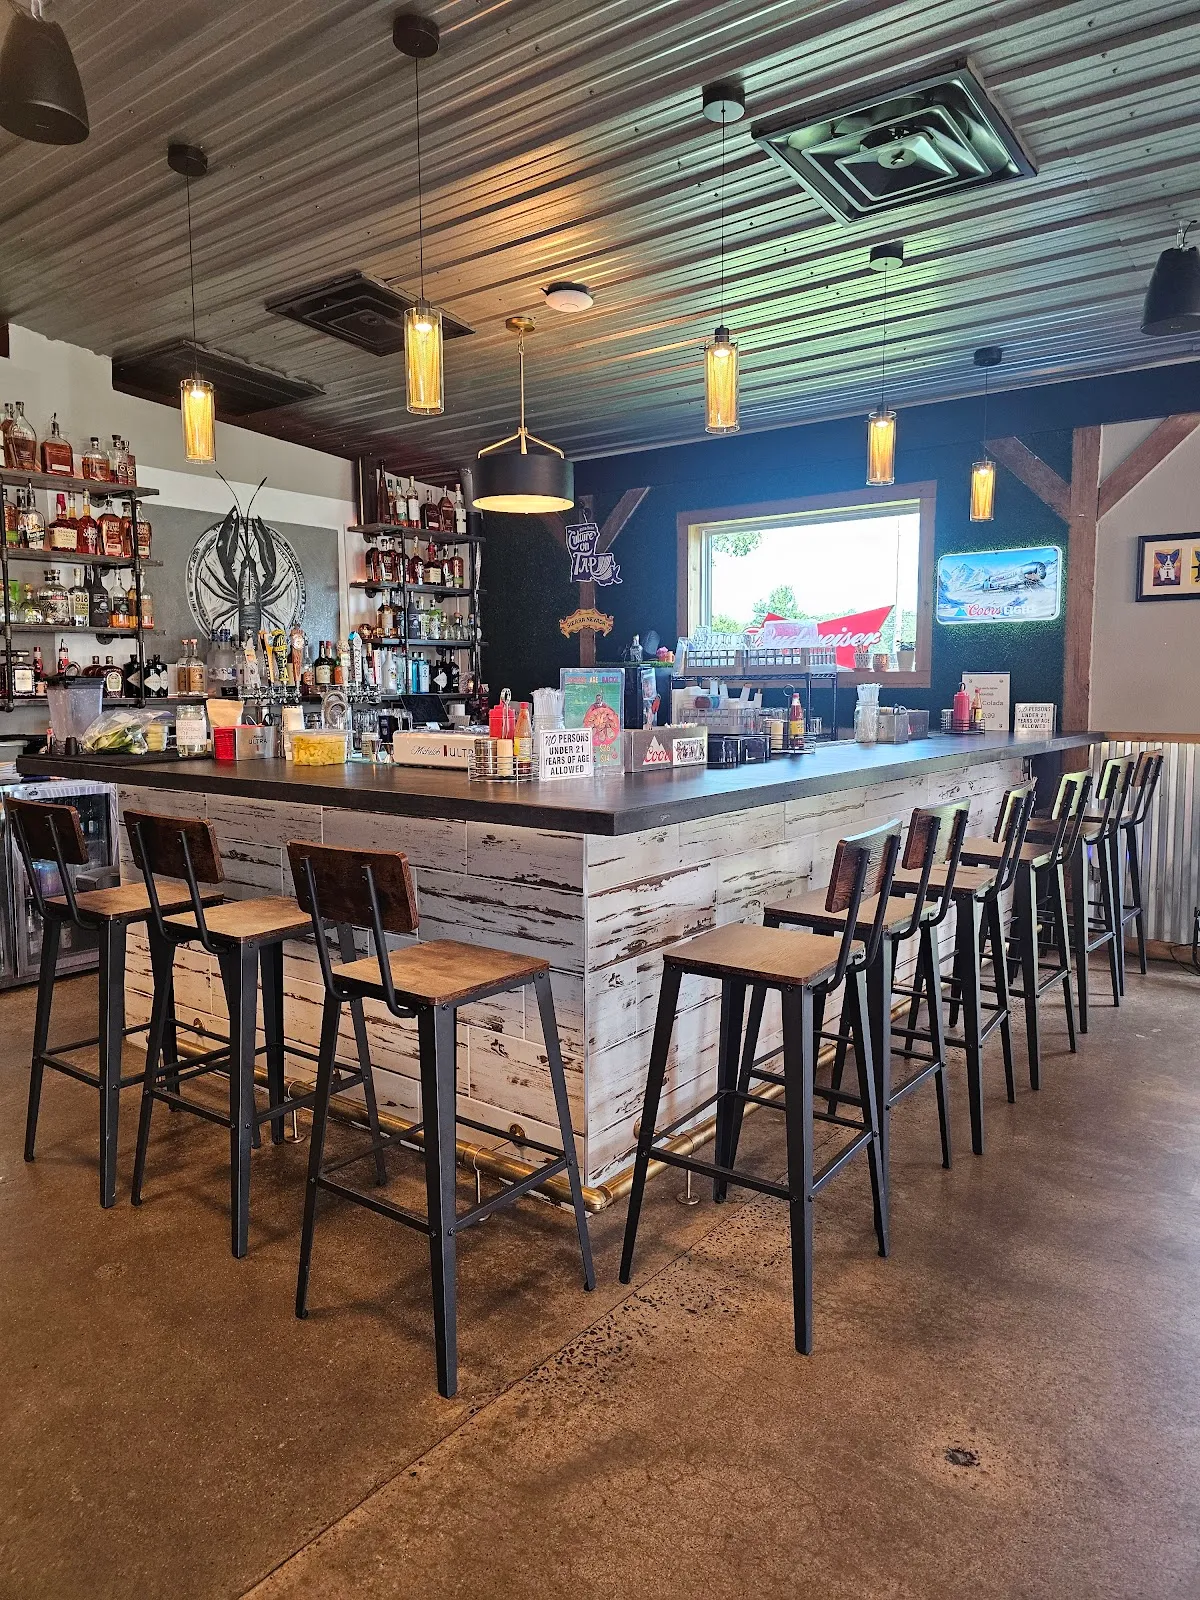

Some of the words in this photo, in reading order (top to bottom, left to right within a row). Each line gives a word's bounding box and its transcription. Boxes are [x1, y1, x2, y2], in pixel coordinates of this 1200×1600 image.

[568, 530, 596, 550] Culture
[580, 542, 590, 551] on
[573, 549, 597, 575] TAP
[75, 594, 89, 603] 818
[968, 604, 1001, 617] Coors
[545, 734, 556, 746] NO
[558, 733, 589, 743] PERSONS
[449, 747, 474, 758] ULTR
[549, 745, 574, 756] UNDER
[575, 745, 584, 753] 21
[567, 755, 576, 764] OF
[577, 754, 590, 763] AGE
[550, 765, 585, 775] ALLOWED
